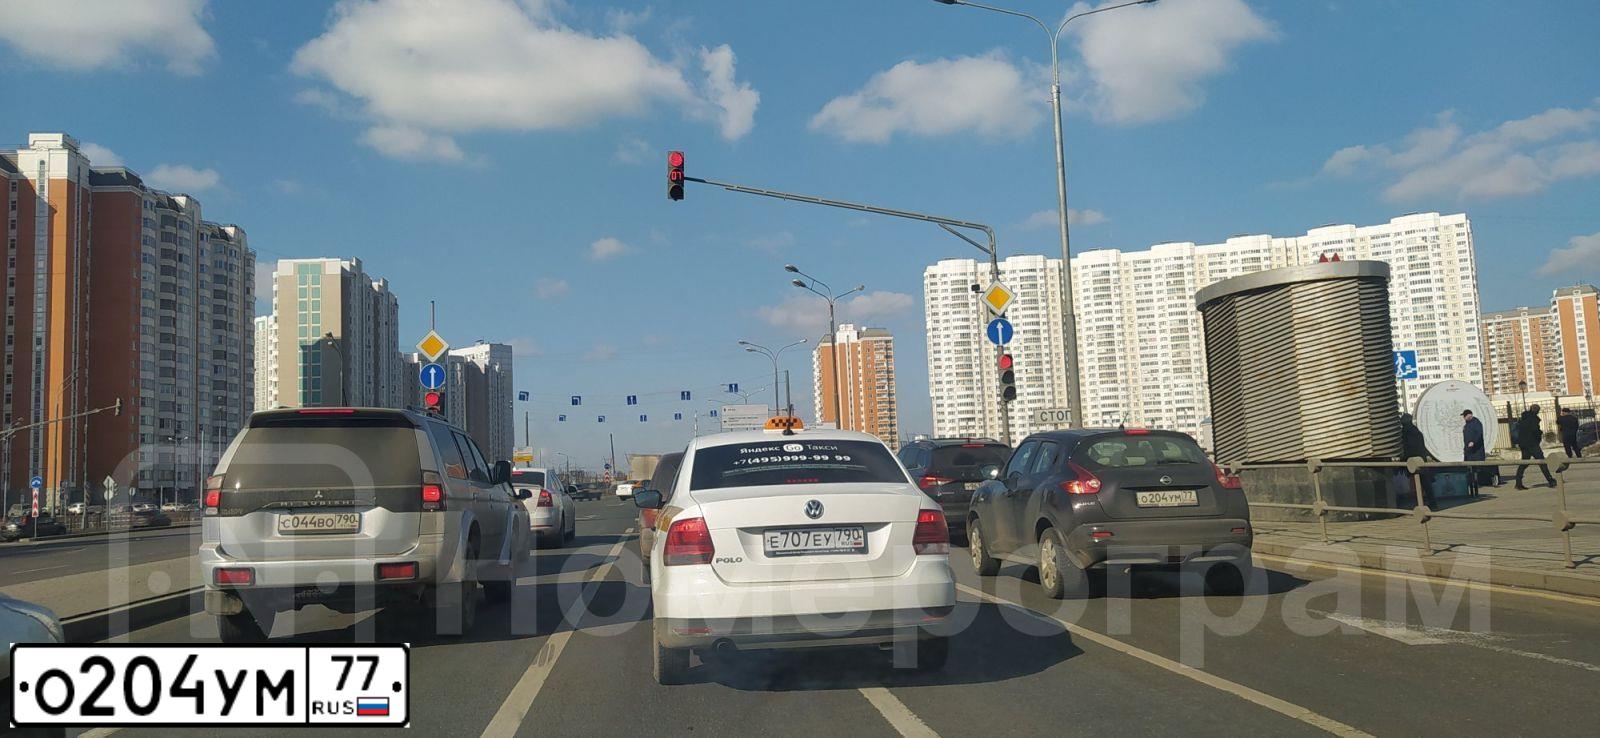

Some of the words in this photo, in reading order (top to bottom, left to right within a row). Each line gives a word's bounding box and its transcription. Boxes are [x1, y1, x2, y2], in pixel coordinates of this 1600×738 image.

[671, 171, 682, 181] 07
[740, 445, 780, 454] Яндекс
[1141, 493, 1182, 503] О204УМ
[282, 515, 334, 528] С044ВО
[337, 514, 356, 524] 790
[770, 530, 832, 548] Е707ЕУ
[836, 528, 859, 541] 790
